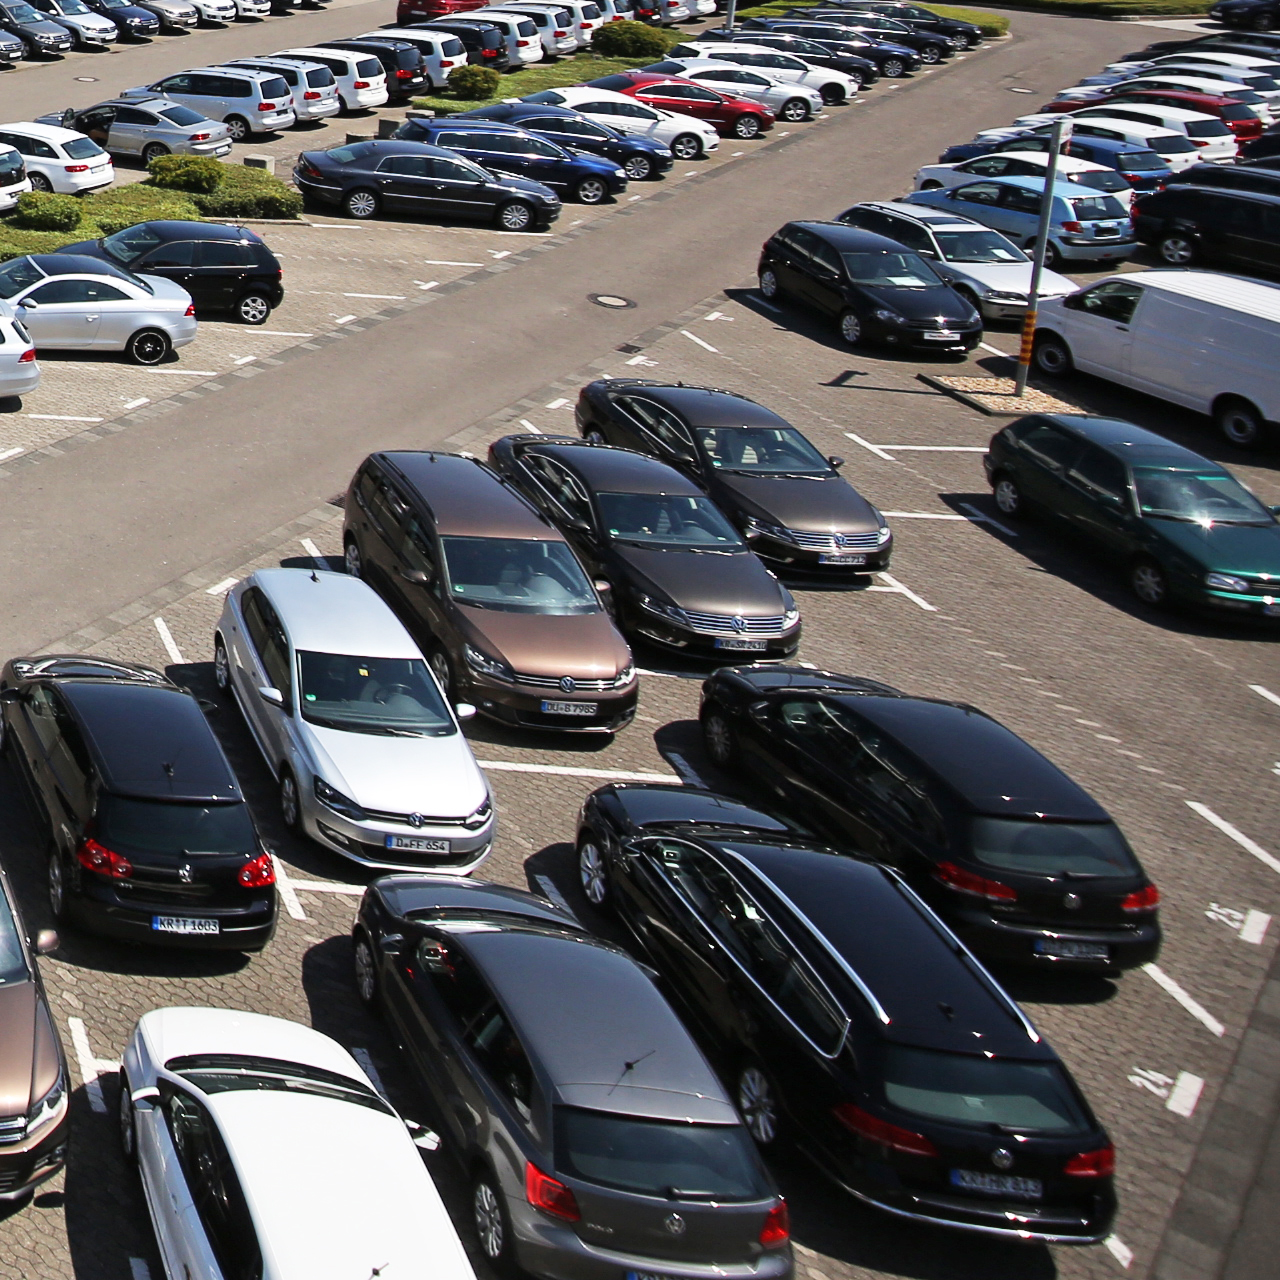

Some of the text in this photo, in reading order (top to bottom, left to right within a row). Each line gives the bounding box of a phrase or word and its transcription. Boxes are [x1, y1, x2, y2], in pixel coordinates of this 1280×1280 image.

[547, 702, 558, 711] DU
[396, 838, 445, 851] D FF 654
[159, 917, 173, 929] KR
